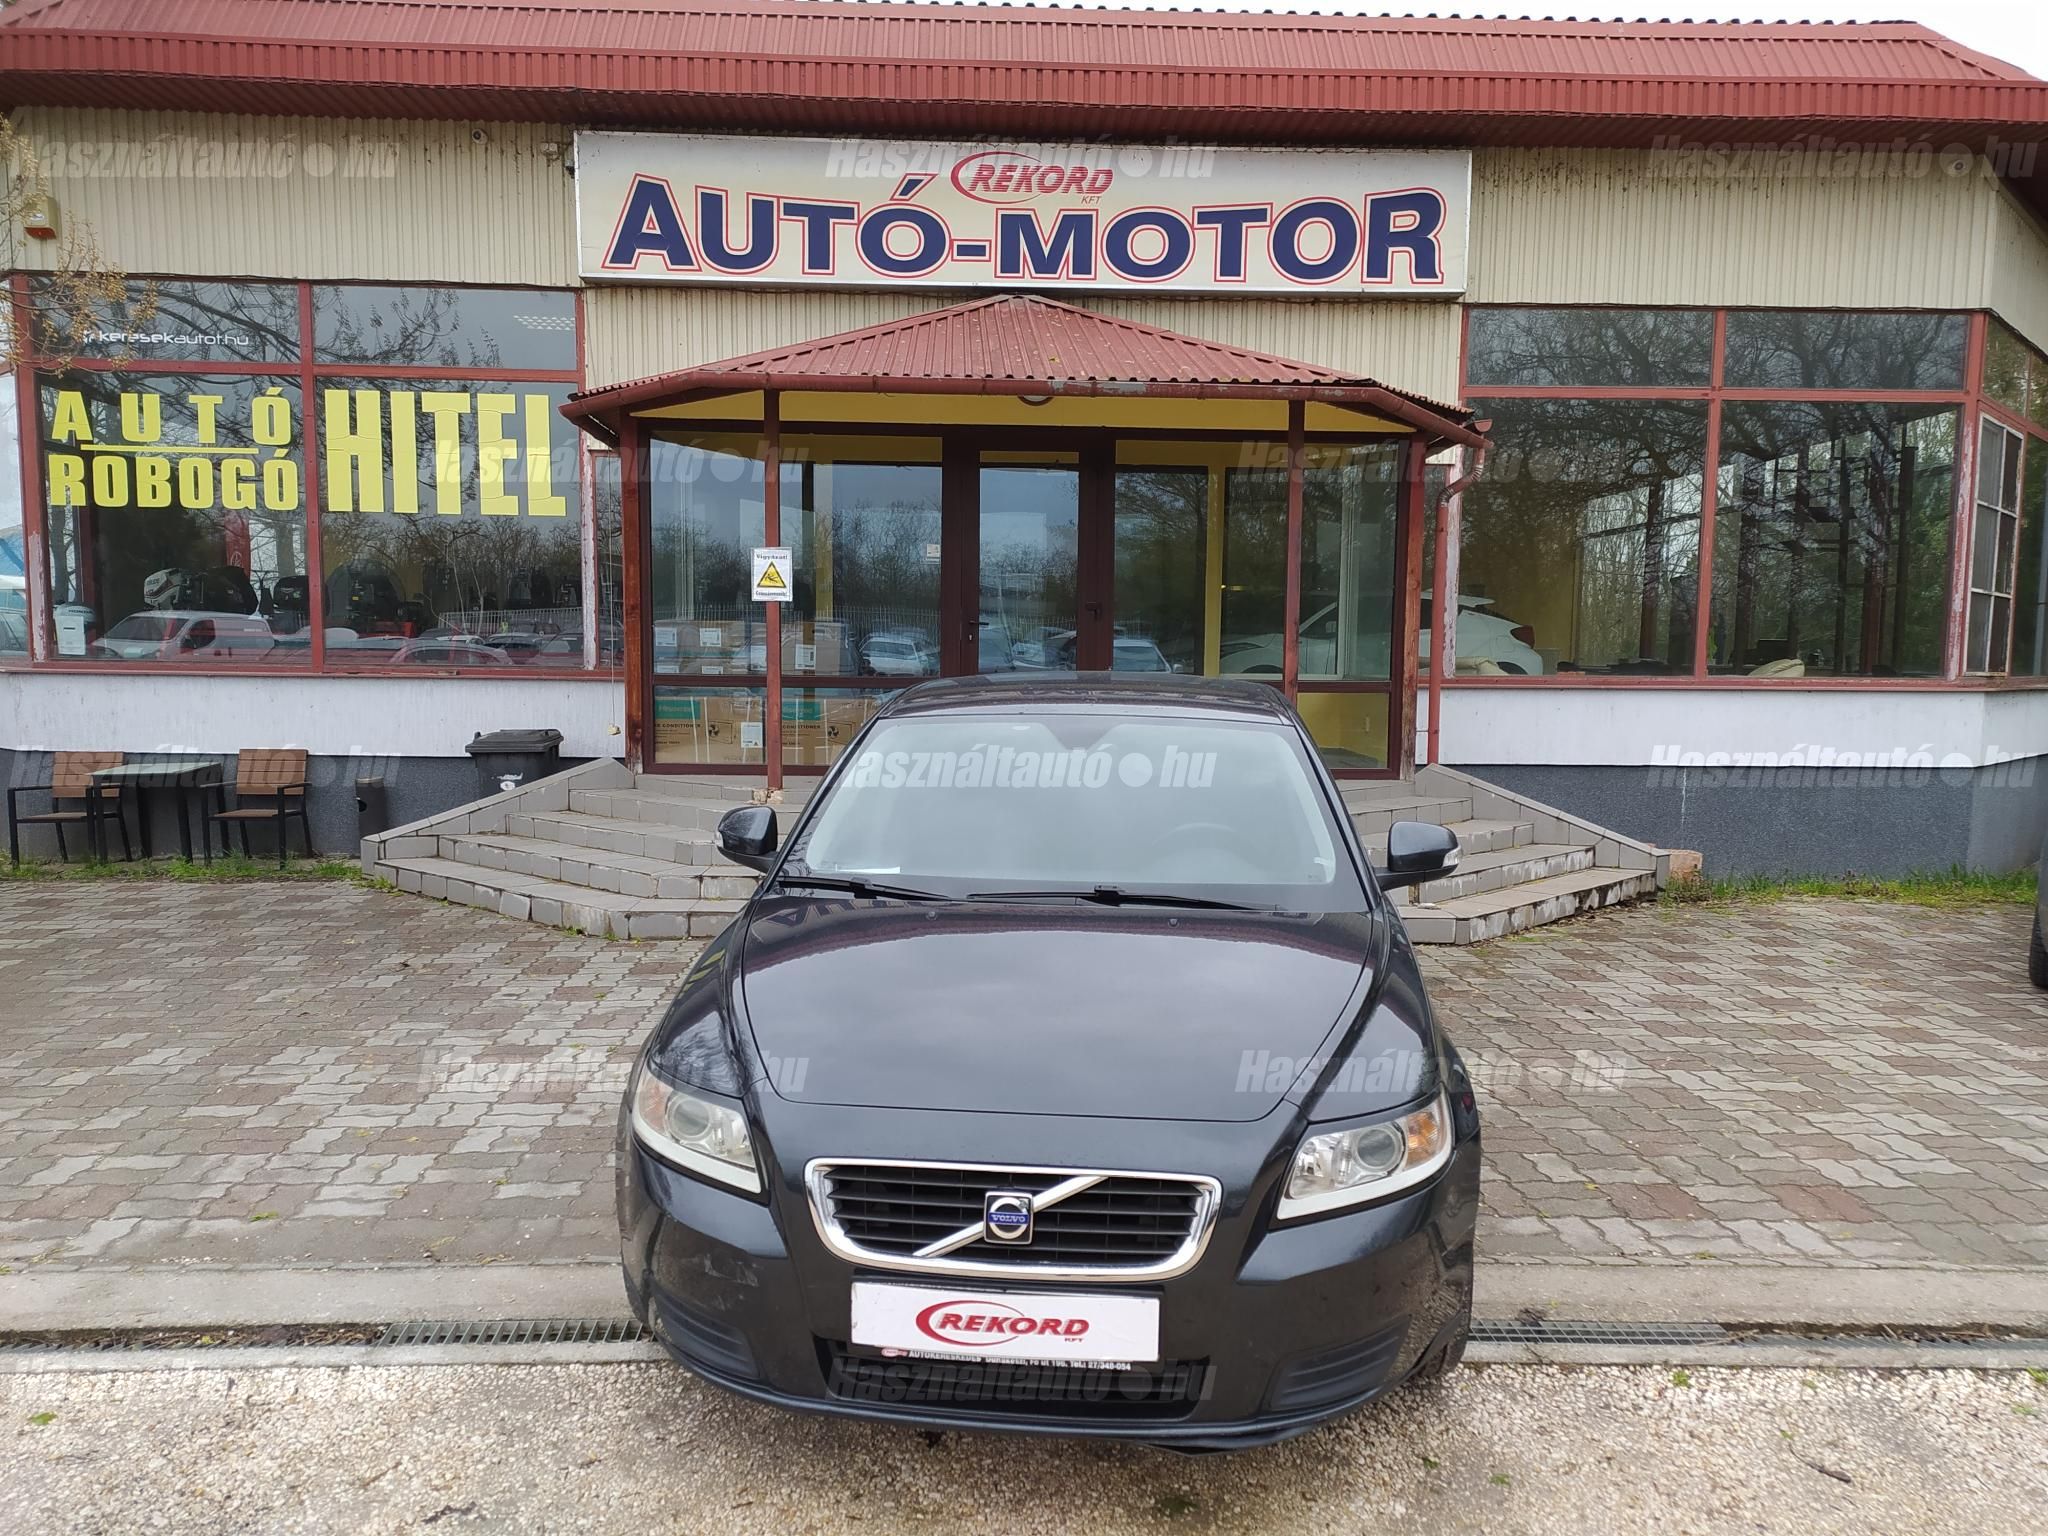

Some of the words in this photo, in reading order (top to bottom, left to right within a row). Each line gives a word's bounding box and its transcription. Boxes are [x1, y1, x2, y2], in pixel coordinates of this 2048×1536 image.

[968, 163, 1114, 195] REKORD
[601, 172, 1448, 285] AUTÓ-MOTOR
[51, 387, 291, 446] AUTÓ
[324, 388, 567, 517] HITEL
[48, 448, 299, 511] ROBOGÓ
[991, 1214, 1026, 1223] VOLVO
[938, 1312, 1089, 1336] REKORD
